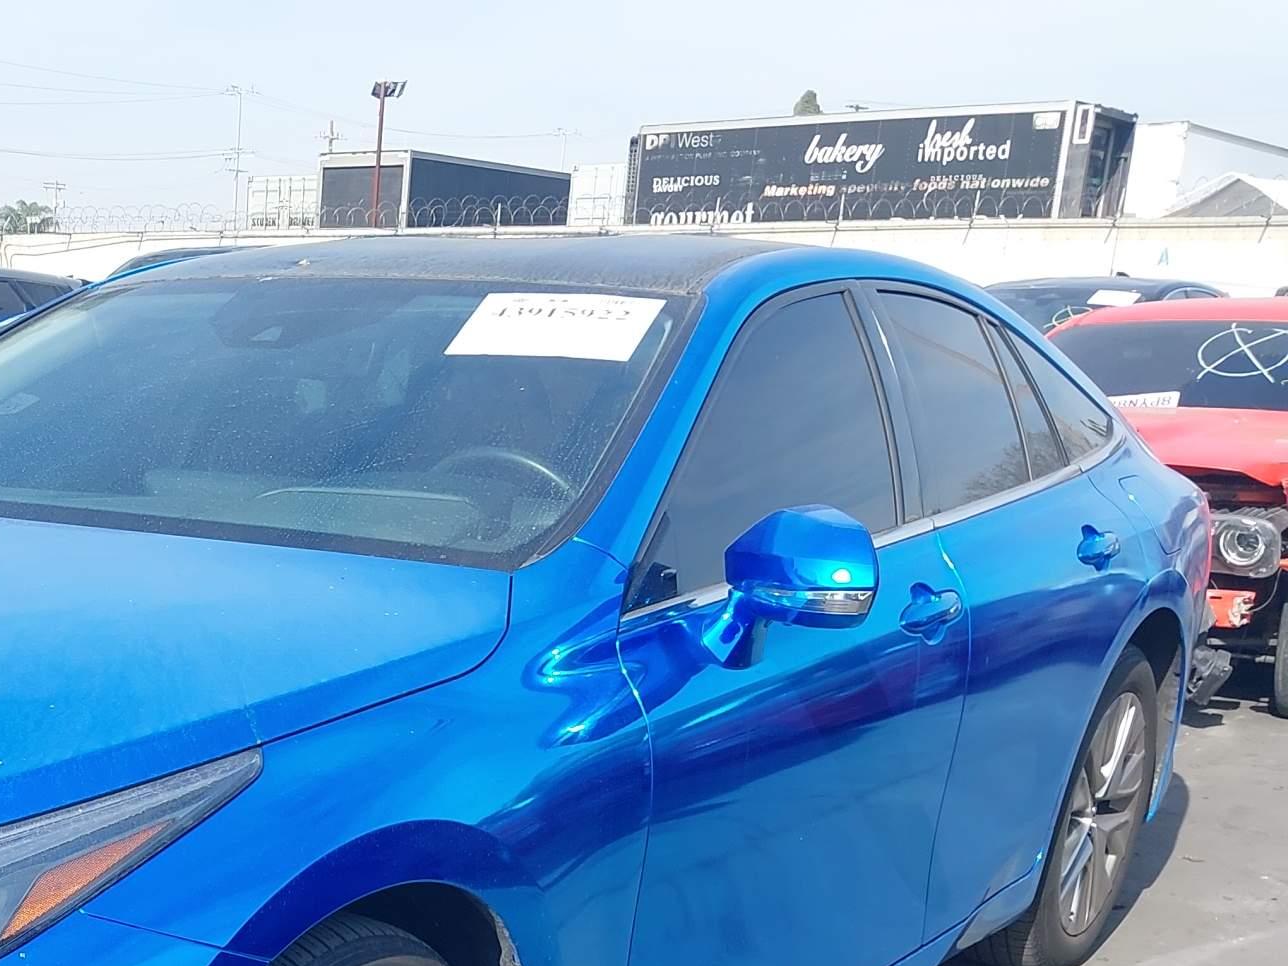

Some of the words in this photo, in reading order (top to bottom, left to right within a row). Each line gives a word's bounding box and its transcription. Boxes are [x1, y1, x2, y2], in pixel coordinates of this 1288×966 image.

[678, 132, 713, 148] West
[803, 133, 885, 173] bakery
[917, 140, 1011, 166] imported
[653, 175, 720, 187] DELICIOUS
[763, 183, 835, 198] Marketing
[912, 178, 955, 191] foods
